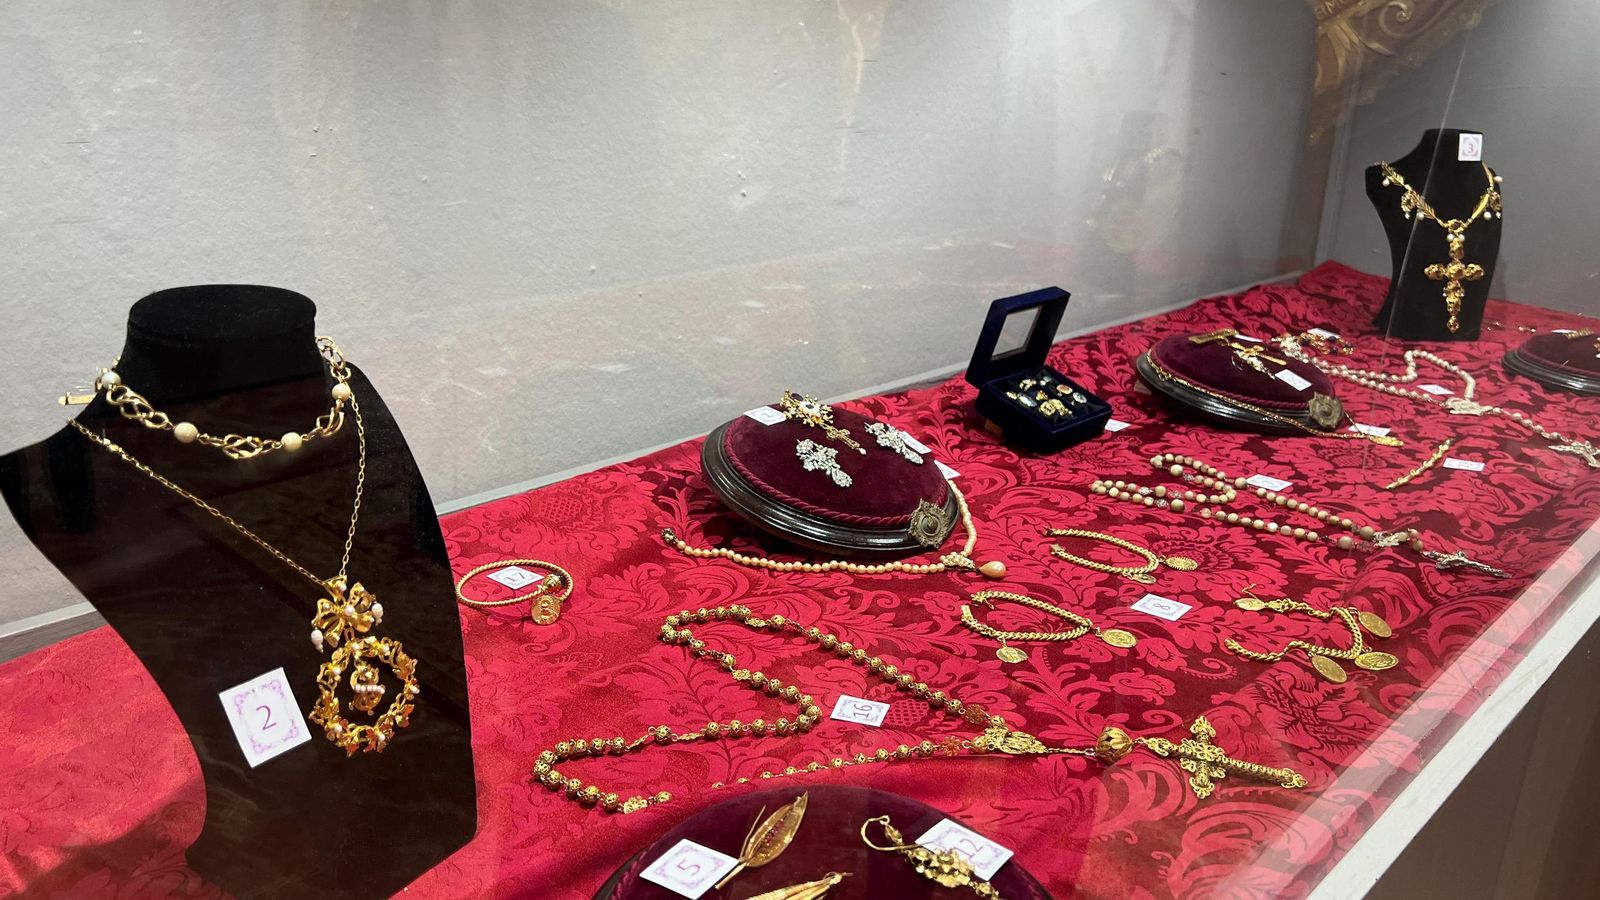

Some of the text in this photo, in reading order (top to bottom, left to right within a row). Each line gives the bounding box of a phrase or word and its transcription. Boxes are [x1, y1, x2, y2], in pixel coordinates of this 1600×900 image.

[1467, 143, 1474, 154] 3
[504, 571, 525, 582] 17
[1152, 602, 1171, 611] 8
[256, 704, 277, 730] 2
[852, 703, 873, 719] 16
[953, 838, 984, 858] 12
[677, 859, 701, 876] 5
